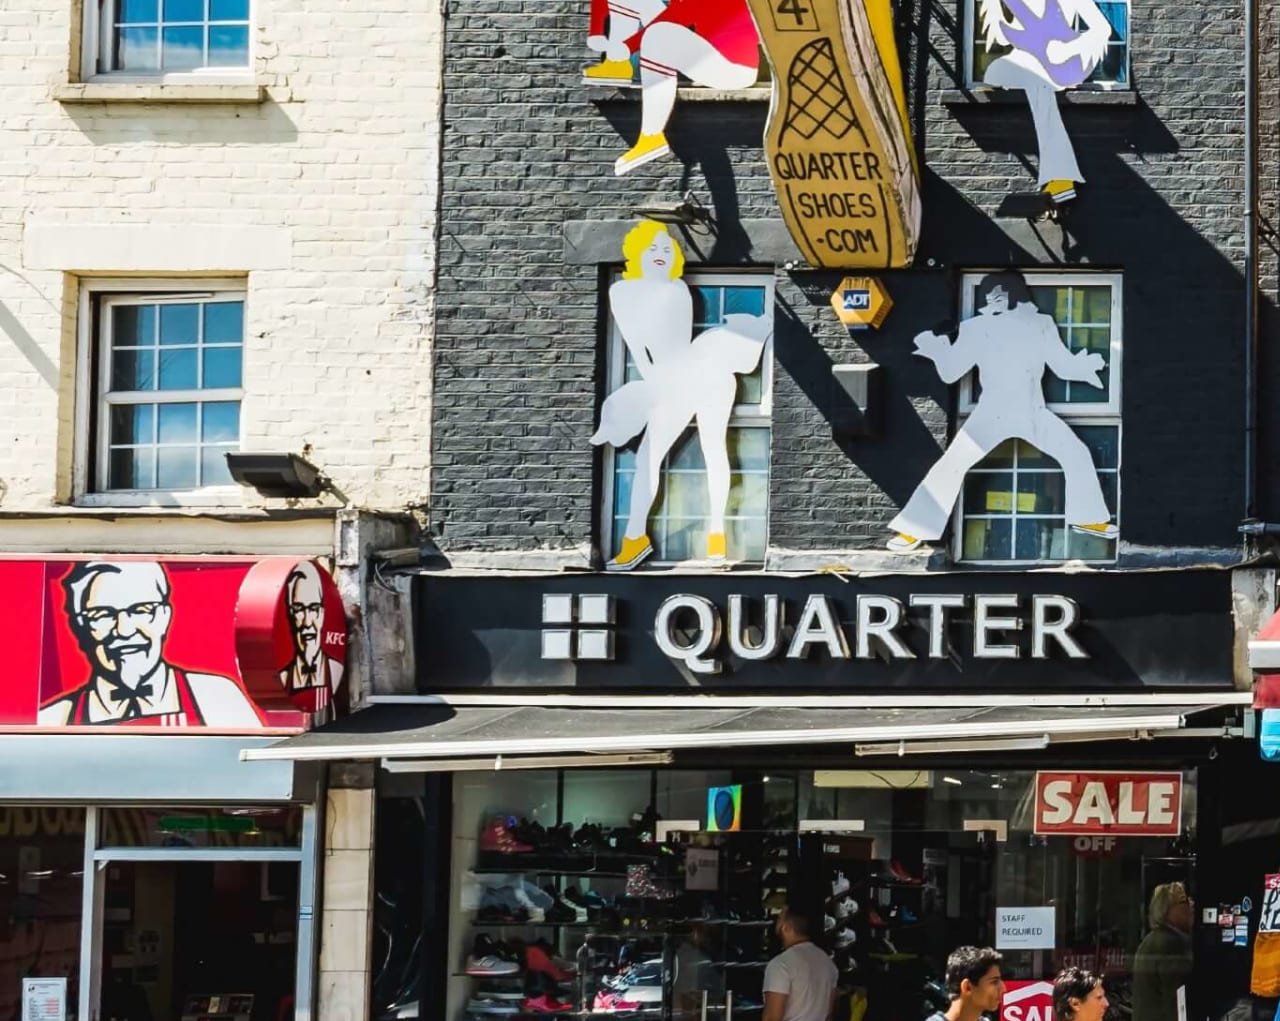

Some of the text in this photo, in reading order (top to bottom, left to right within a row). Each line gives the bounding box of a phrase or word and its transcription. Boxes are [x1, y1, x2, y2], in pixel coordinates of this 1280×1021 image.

[776, 0, 809, 26] 4
[774, 152, 883, 181] QUARTER
[797, 193, 877, 219] SHOES
[844, 293, 870, 306] ADT
[326, 631, 346, 646] KFC
[654, 593, 1092, 673] QUARTER
[1042, 780, 1174, 825] SALE
[1074, 836, 1117, 852] OFF
[1001, 914, 1025, 924] STAFF
[1001, 926, 1043, 937] REQUIRED
